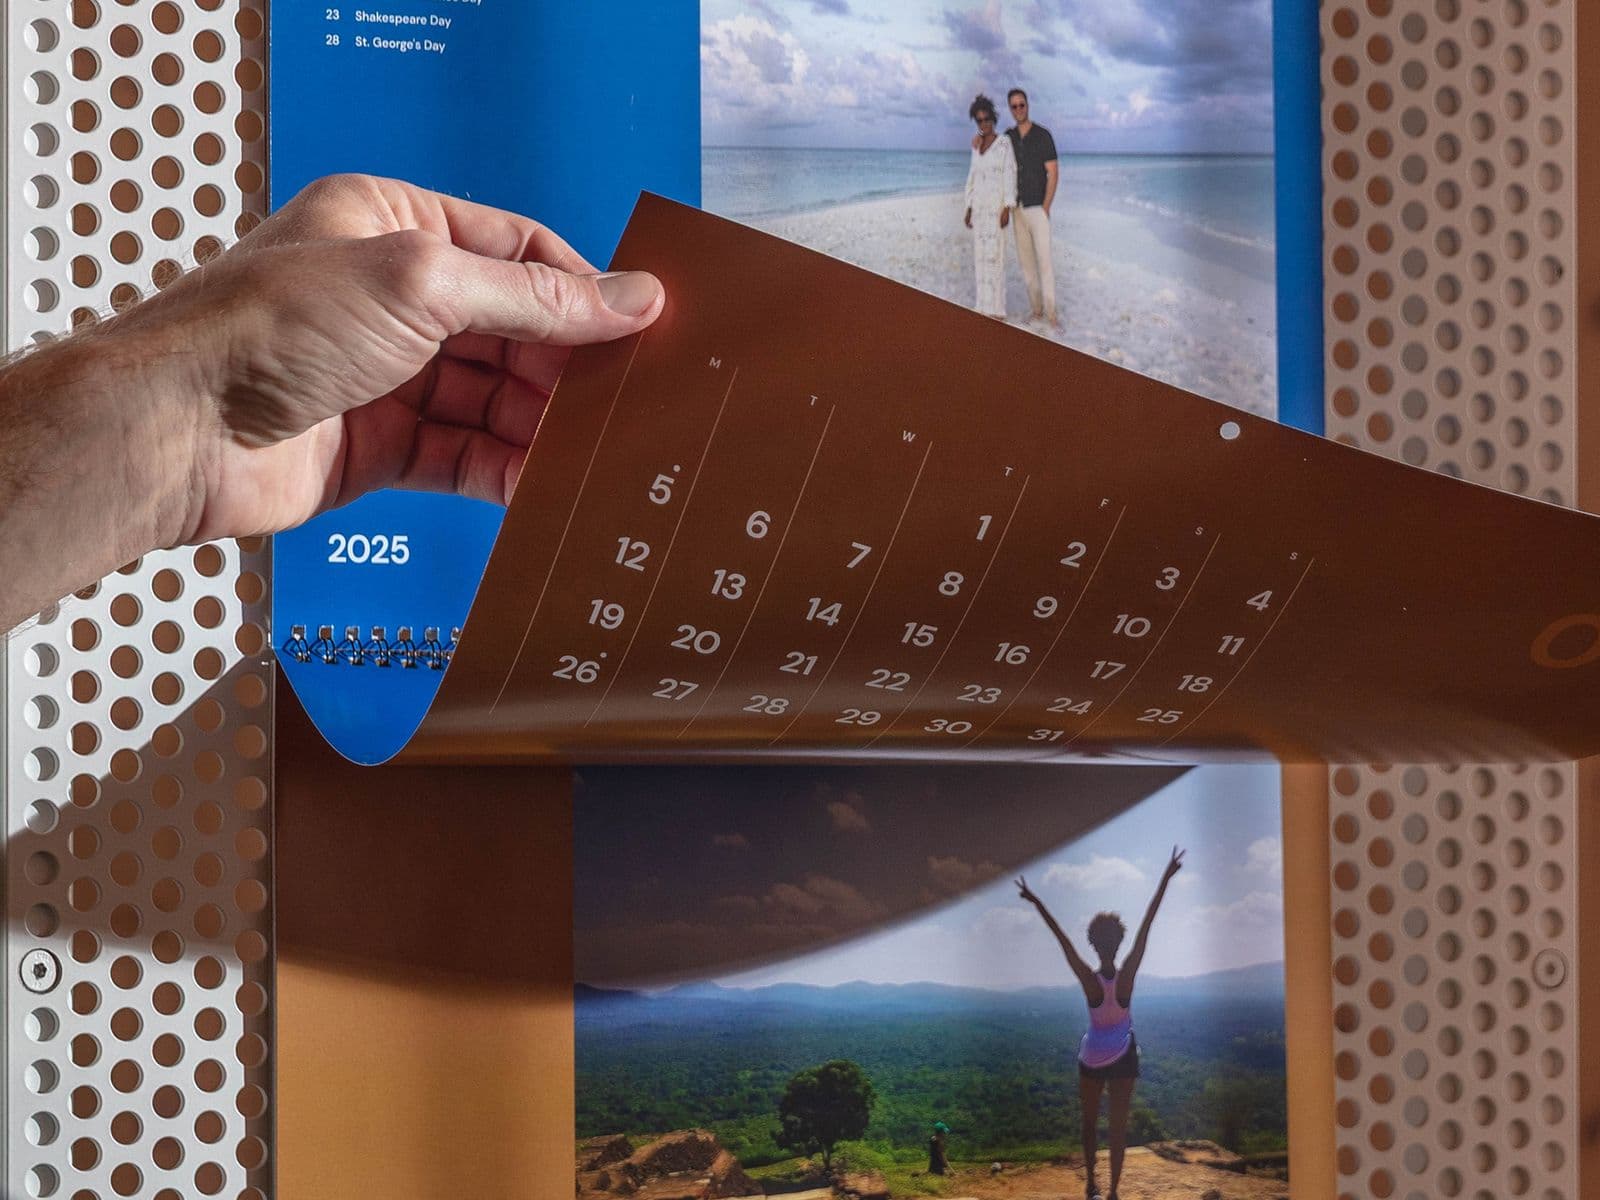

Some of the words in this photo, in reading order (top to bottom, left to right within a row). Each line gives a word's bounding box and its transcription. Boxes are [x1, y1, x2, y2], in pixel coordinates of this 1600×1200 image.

[326, 9, 340, 20] 23
[355, 11, 427, 27] Shakespeare
[430, 15, 451, 29] Day
[326, 35, 340, 45] 28
[355, 36, 370, 47] St.
[373, 37, 421, 51] George's
[424, 40, 445, 53] Day
[709, 357, 721, 369] M
[809, 395, 818, 406] T
[902, 431, 915, 442] W
[1005, 467, 1013, 477] T
[1100, 498, 1109, 507] F
[1195, 527, 1203, 535] S
[1290, 552, 1298, 560] S
[328, 533, 410, 564] 2025
[648, 474, 675, 504] 5
[745, 510, 771, 538] 6
[846, 542, 872, 568] 7
[938, 571, 964, 595] 8
[1034, 596, 1058, 618] 9
[1112, 614, 1151, 637] 10
[1217, 635, 1245, 655] 11
[976, 515, 992, 541] 1
[1060, 542, 1086, 568] 2
[1155, 567, 1181, 589] 3
[1247, 590, 1273, 611] 4
[588, 600, 624, 629] 19
[670, 625, 720, 654] 20
[780, 651, 818, 675] 21
[865, 669, 910, 691] 22
[957, 684, 1001, 703] 23
[1046, 697, 1093, 715] 24
[1137, 708, 1183, 723] 25
[614, 537, 650, 571] 12
[711, 569, 746, 600] 13
[805, 597, 842, 625] 14
[901, 622, 938, 647] 15
[994, 642, 1030, 665] 16
[1090, 661, 1126, 680] 17
[1177, 675, 1213, 693] 18
[552, 655, 600, 683] 26
[652, 678, 698, 701] 27
[742, 695, 789, 715] 28
[835, 708, 881, 725] 29
[924, 719, 972, 734] 30
[1027, 729, 1064, 741] 31
